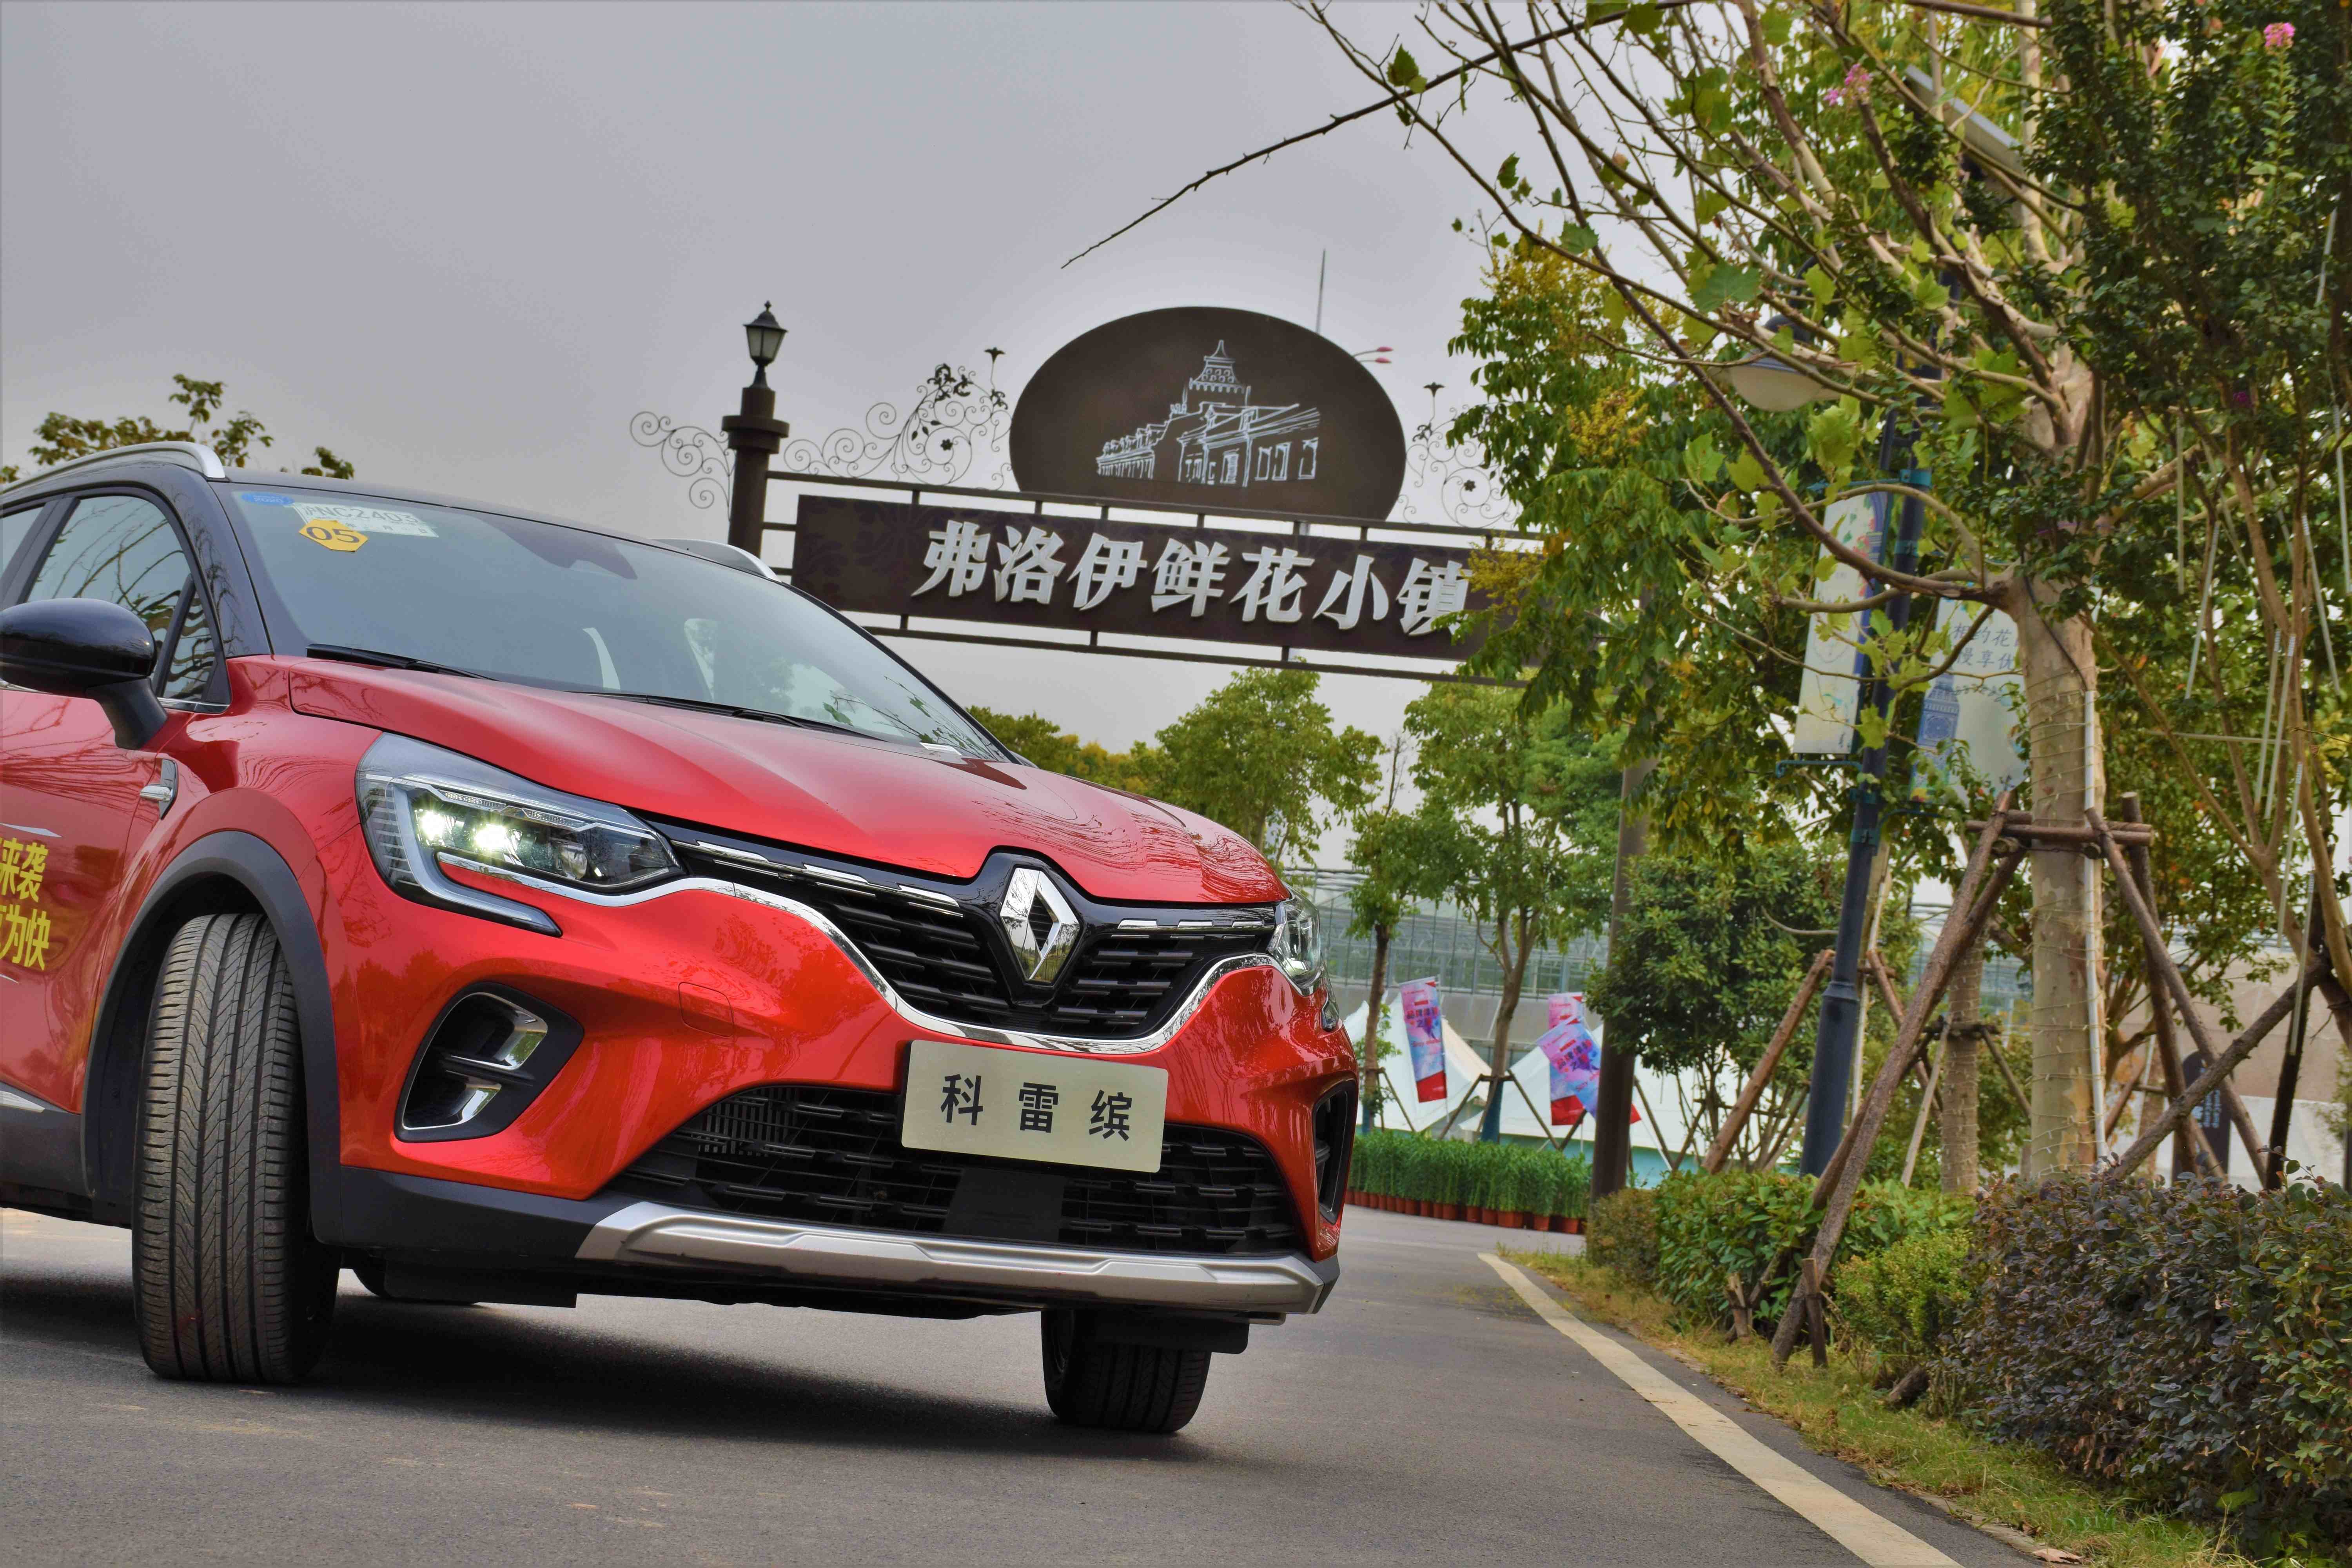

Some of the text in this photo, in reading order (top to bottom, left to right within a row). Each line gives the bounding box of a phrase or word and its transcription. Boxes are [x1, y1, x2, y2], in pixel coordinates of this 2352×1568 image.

[306, 526, 360, 543] 05
[911, 519, 1473, 636] 弗洛伊鲜花小镇
[1951, 622, 2019, 647] 相约花
[0, 837, 49, 902] 来袭
[940, 1073, 1132, 1142] 科雷缤
